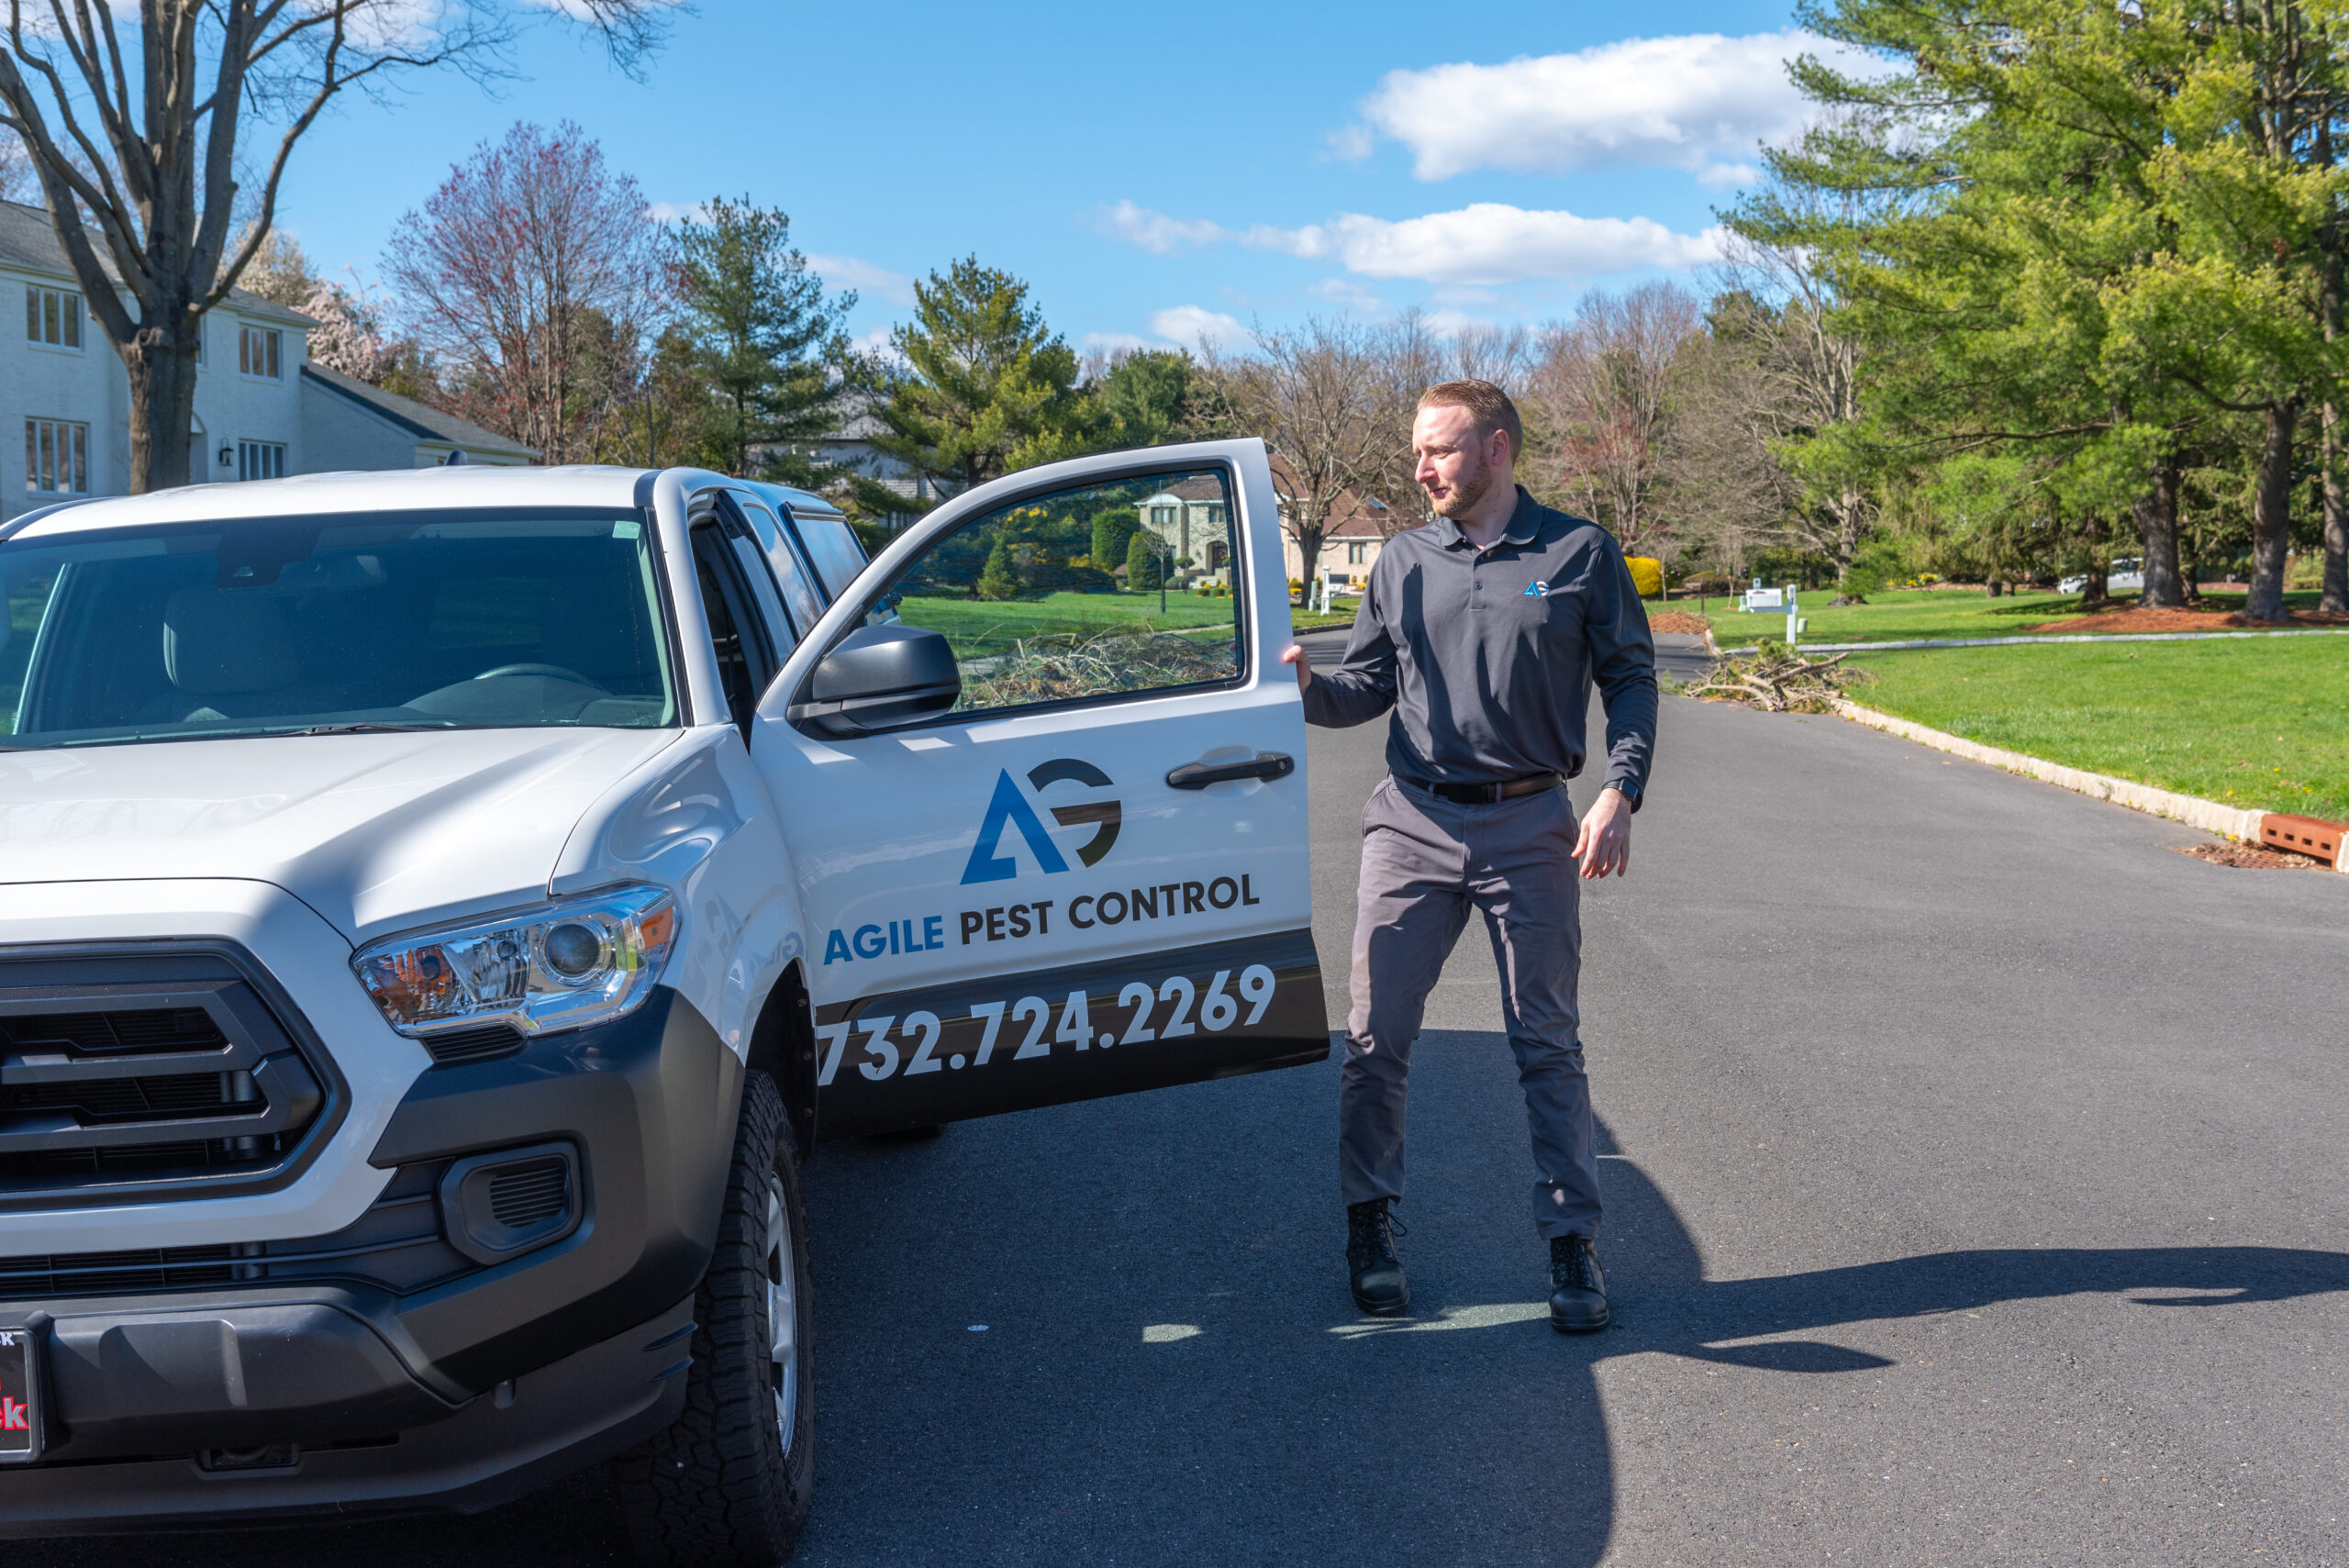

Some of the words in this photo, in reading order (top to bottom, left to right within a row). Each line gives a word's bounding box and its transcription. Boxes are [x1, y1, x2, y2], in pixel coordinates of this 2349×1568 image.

[823, 915, 944, 965] AGILE
[960, 900, 1053, 946] PEST
[1068, 873, 1260, 929] CONTROL
[817, 964, 1276, 1086] 732.724.2269
